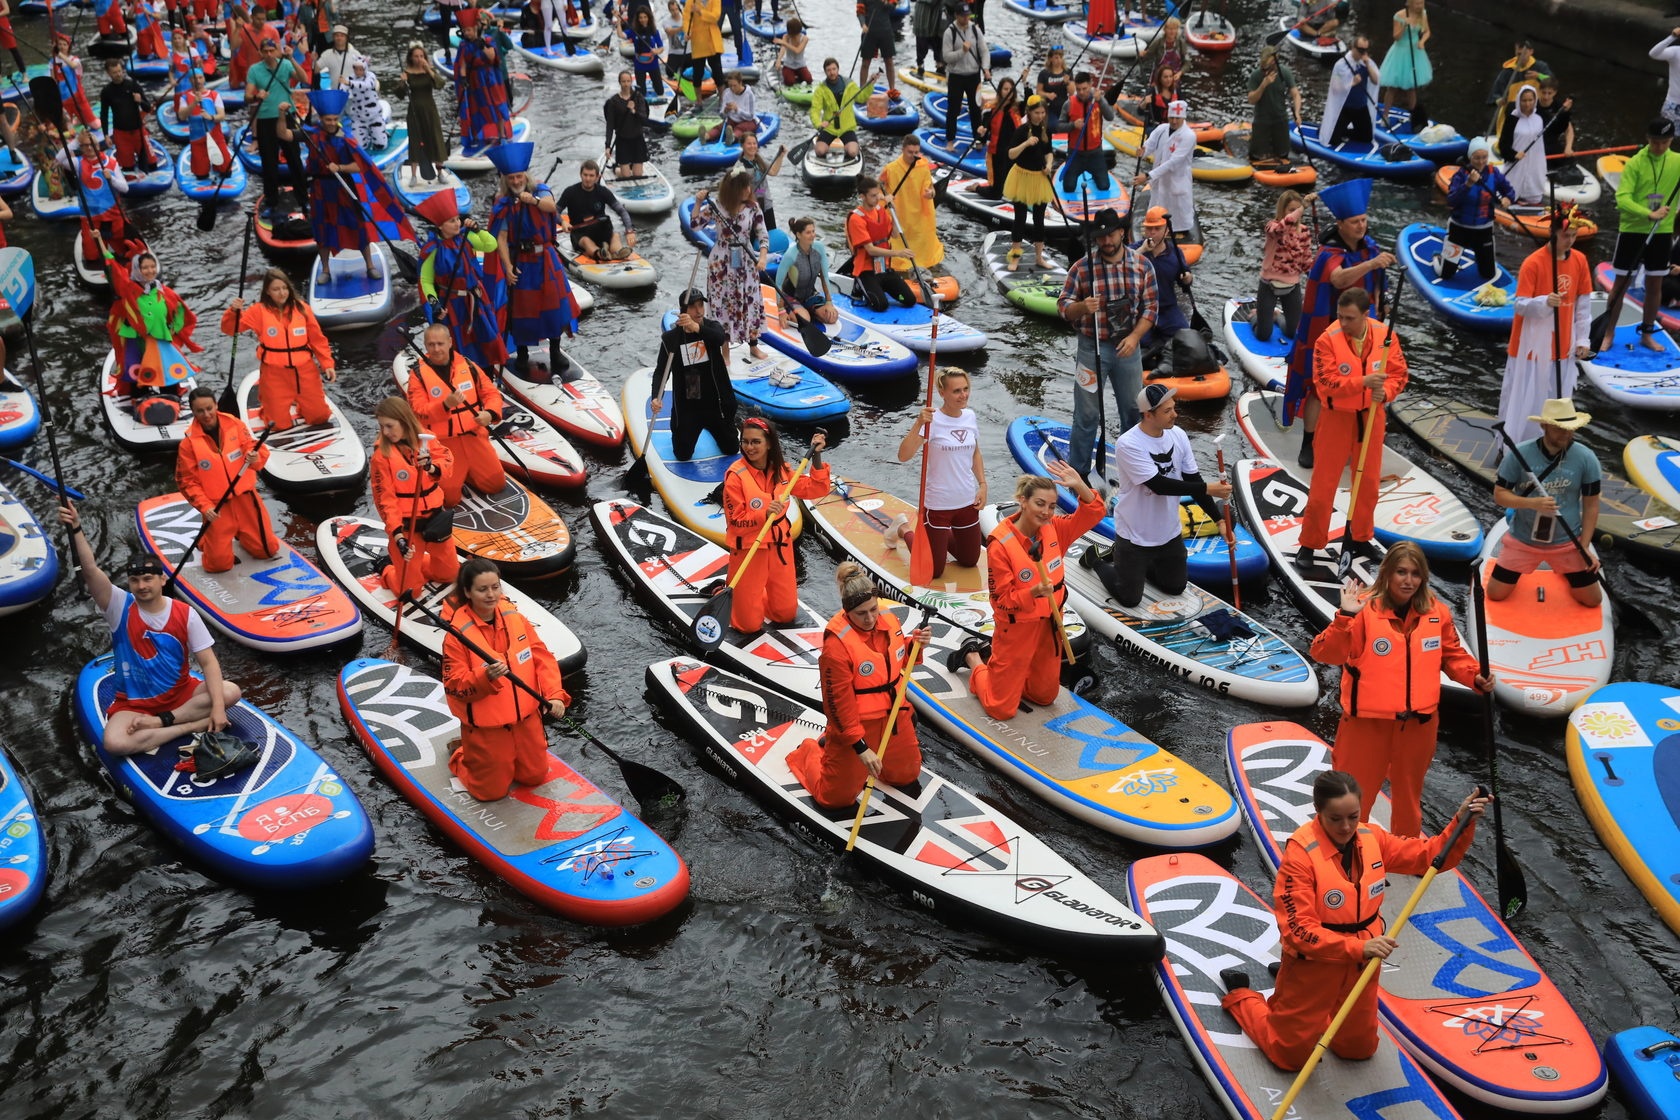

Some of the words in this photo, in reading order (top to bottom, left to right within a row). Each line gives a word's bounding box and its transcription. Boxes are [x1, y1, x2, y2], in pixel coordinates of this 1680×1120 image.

[1114, 633, 1192, 678] POWERMAX
[1530, 692, 1549, 701] 499
[980, 716, 1018, 737] ARII
[1014, 736, 1050, 757] NUI
[443, 787, 481, 810] ARII
[472, 808, 507, 831] NUI
[912, 890, 936, 910] PRO
[1042, 890, 1133, 928] GLADIATOR
